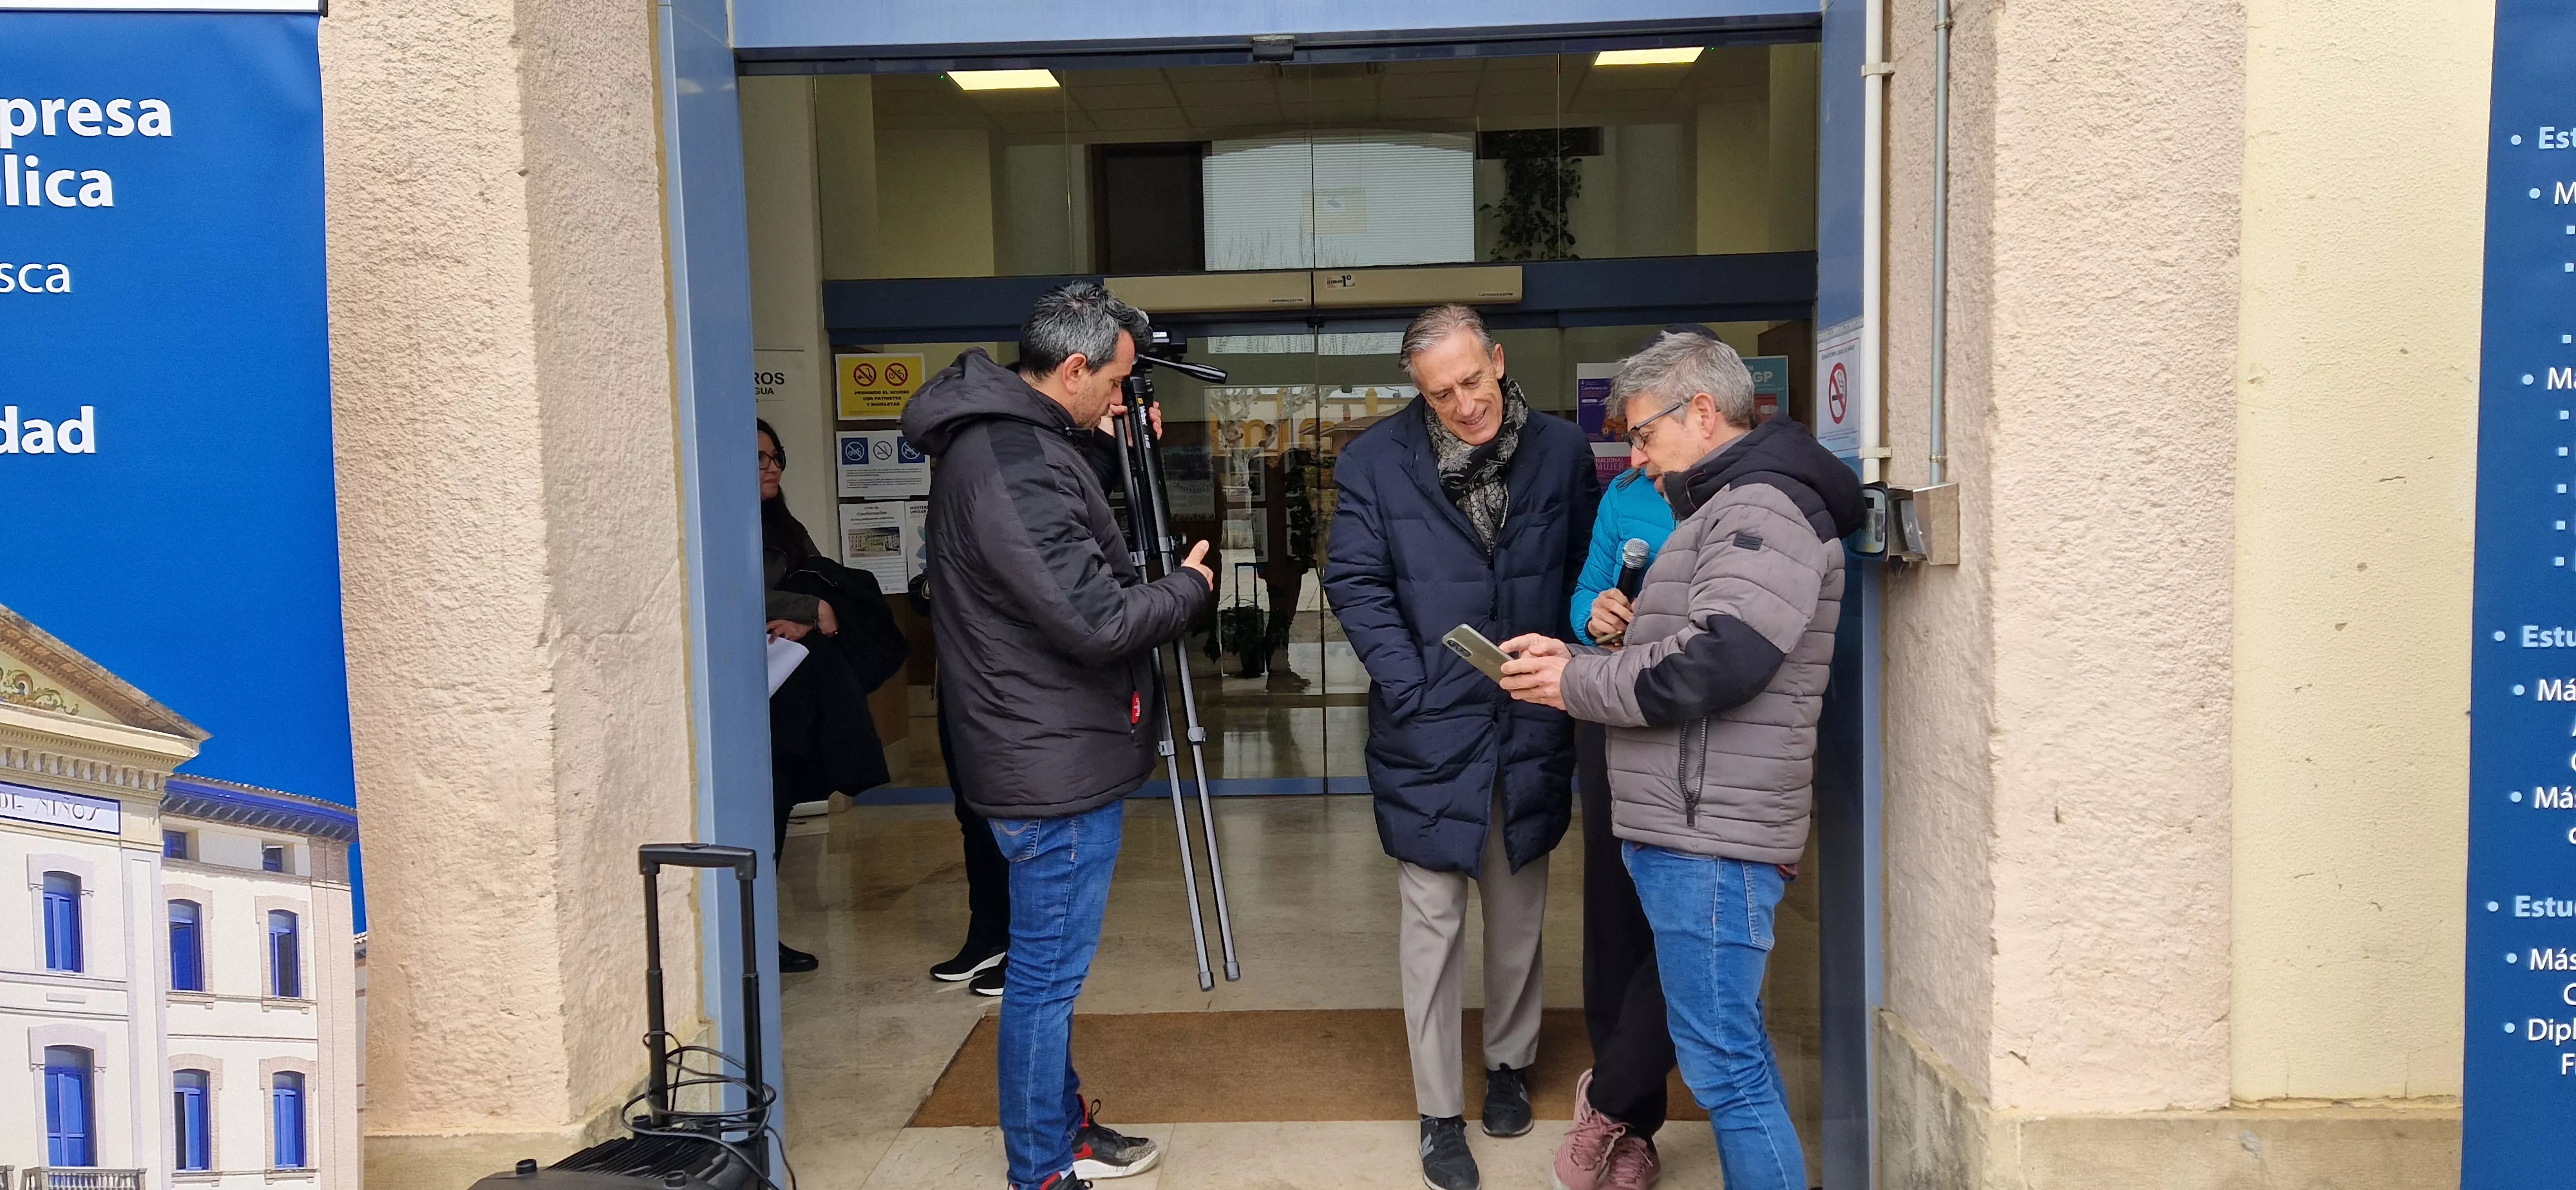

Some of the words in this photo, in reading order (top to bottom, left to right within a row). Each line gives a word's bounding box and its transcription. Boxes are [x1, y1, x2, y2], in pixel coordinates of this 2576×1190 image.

[0, 154, 114, 207] lica
[2547, 367, 2576, 390] M
[2534, 786, 2576, 809] Má
[2515, 895, 2576, 918] Estu
[2562, 1053, 2576, 1075] F
